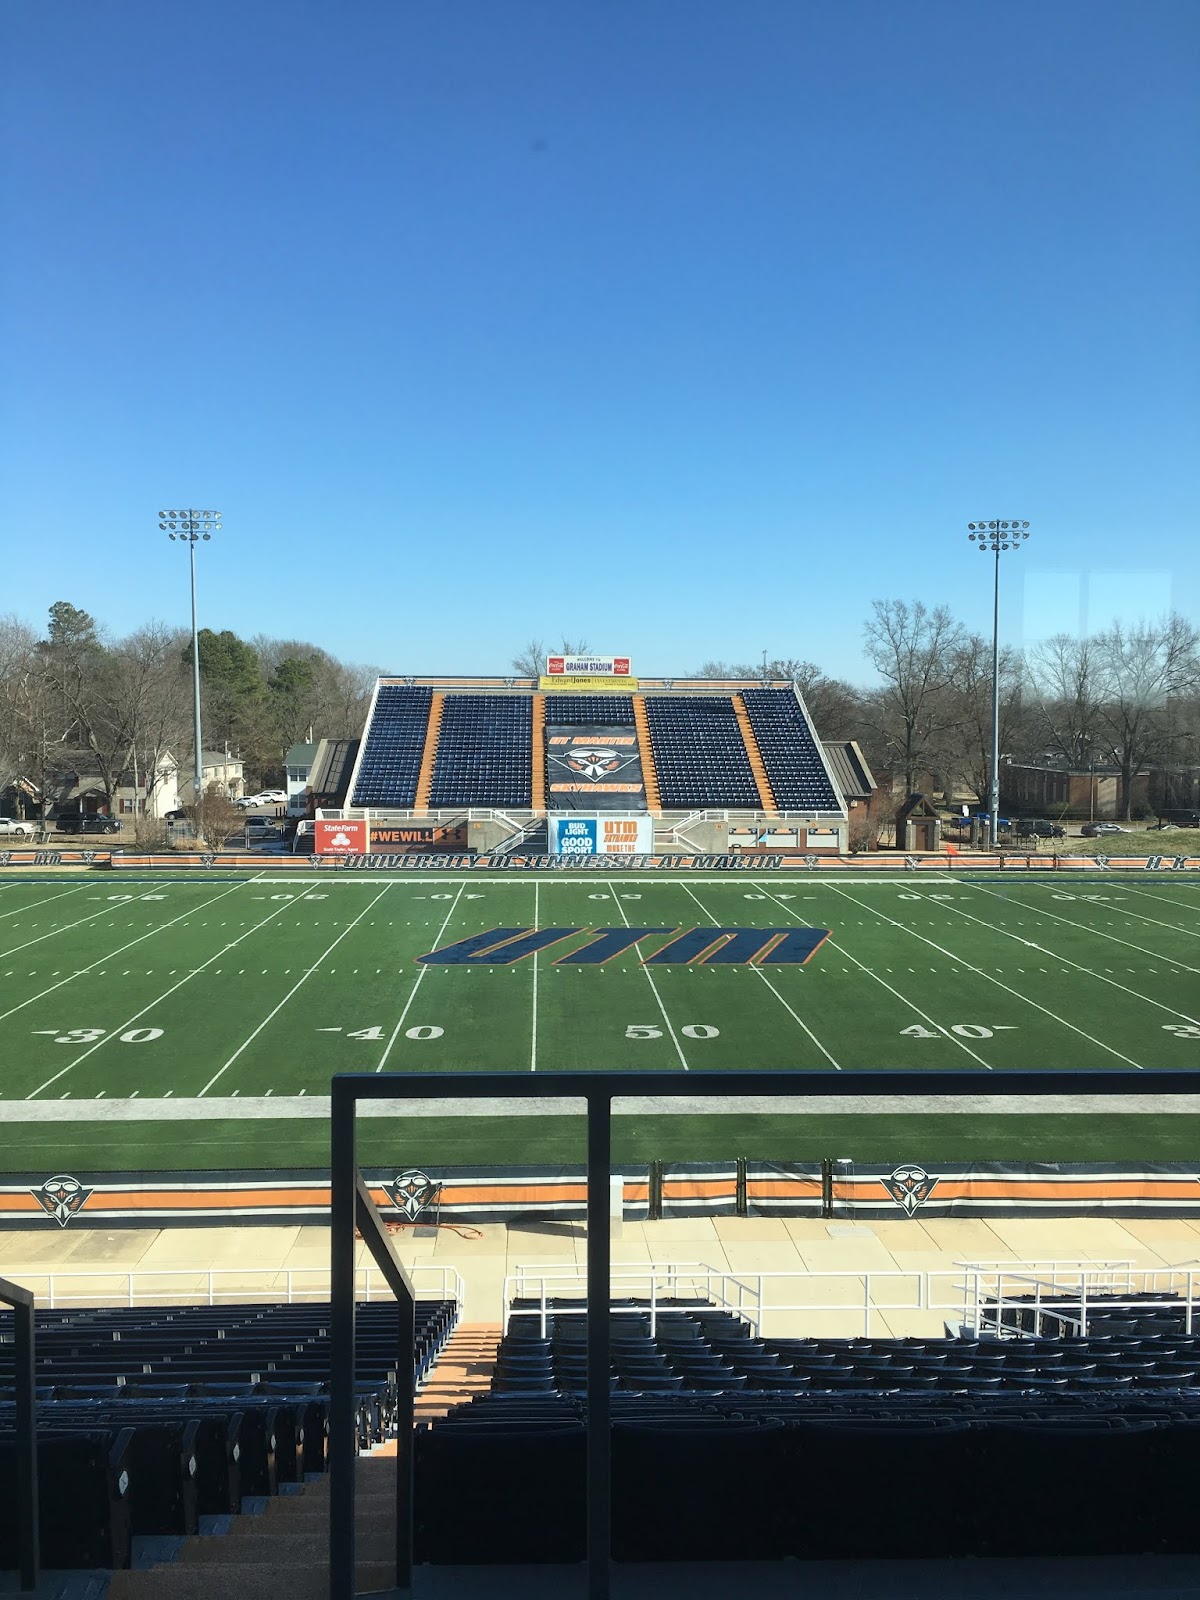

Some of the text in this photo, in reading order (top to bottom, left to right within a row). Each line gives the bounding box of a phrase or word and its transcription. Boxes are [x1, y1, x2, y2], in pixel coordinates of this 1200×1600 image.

[566, 662, 589, 671] GRAHAM
[589, 662, 613, 672] STADIUM
[549, 736, 636, 746] UT MARTIN
[550, 783, 643, 793] SKYHAWKS
[604, 821, 637, 833] UTM
[561, 837, 593, 847] GOOD
[603, 834, 638, 842] SKYHAWKS
[561, 846, 593, 854] SPORT
[624, 844, 636, 852] THE
[343, 854, 785, 869] UNIVERSITY OF TENNESSEE AT MARTIN
[413, 927, 834, 966] UTM
